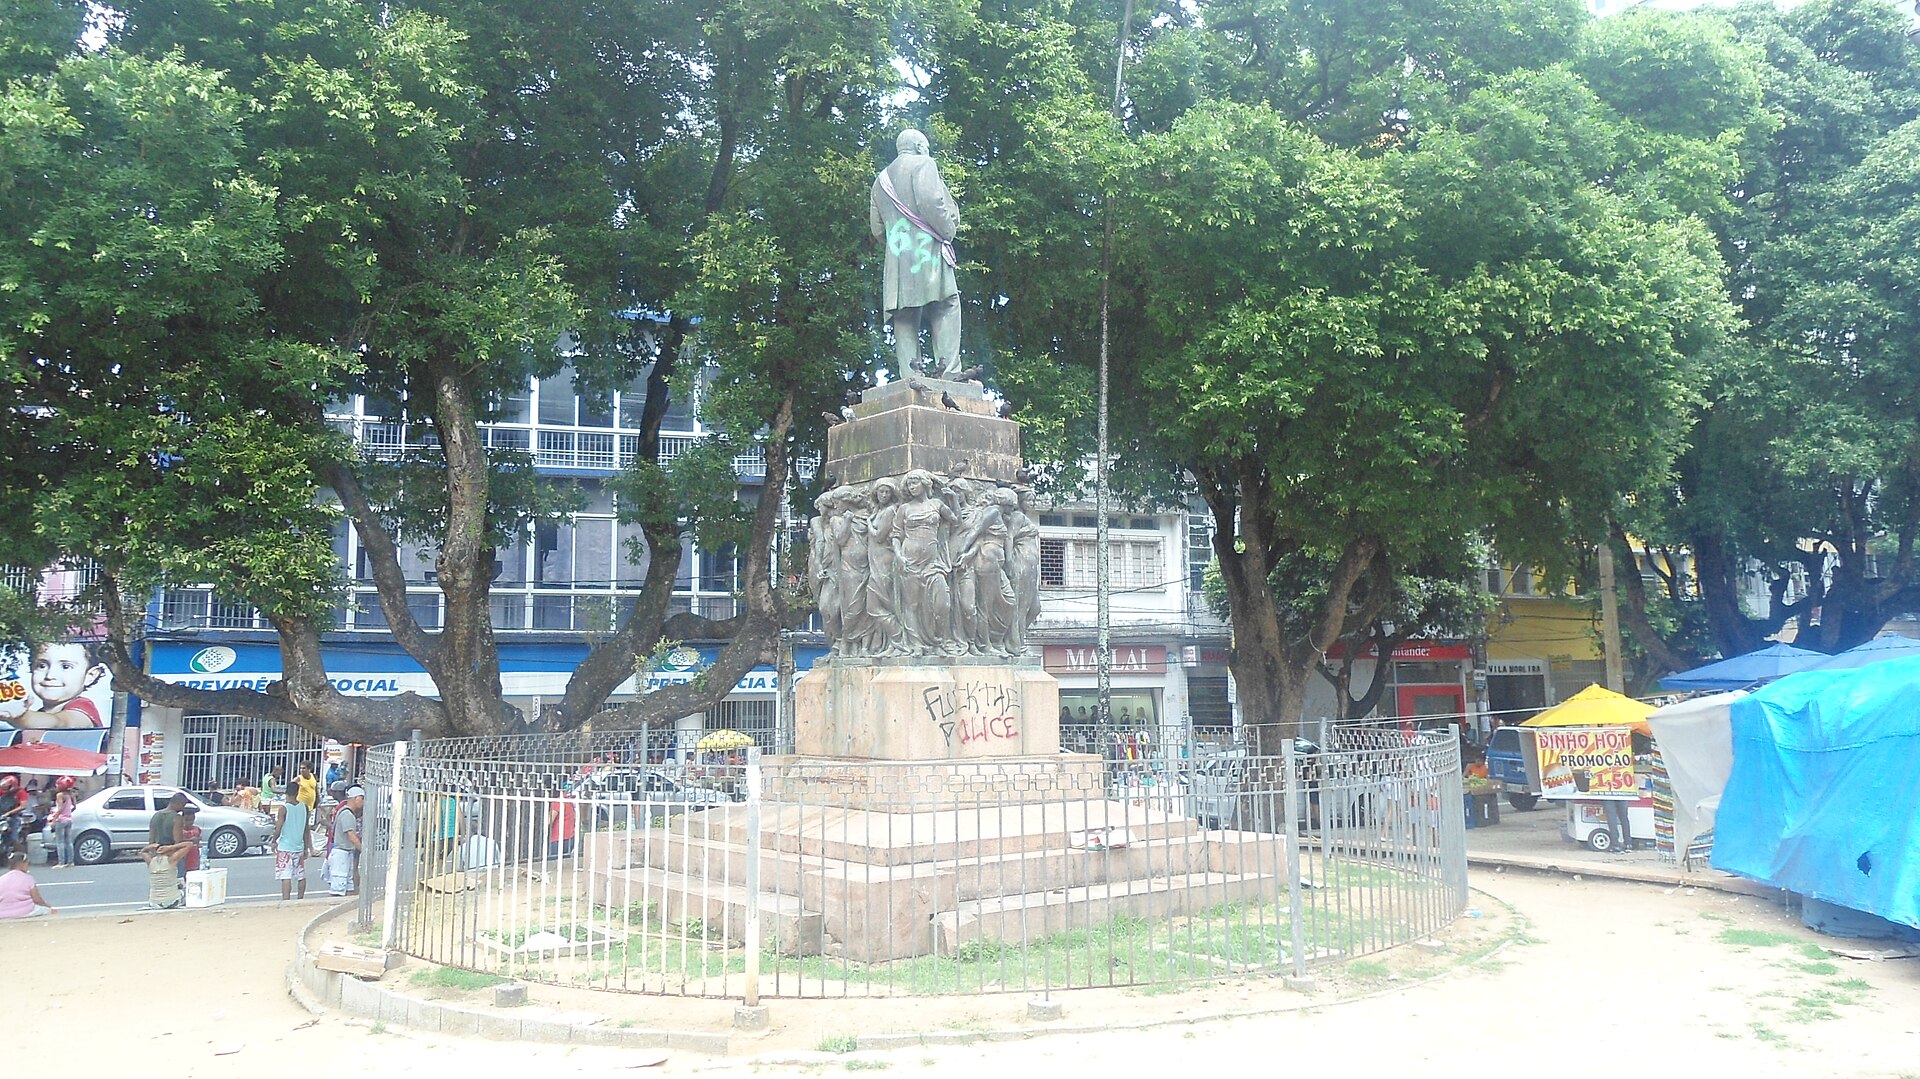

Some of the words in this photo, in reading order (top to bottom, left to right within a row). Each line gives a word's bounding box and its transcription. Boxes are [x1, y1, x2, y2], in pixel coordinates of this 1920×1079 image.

[1391, 644, 1430, 656] ntander
[328, 678, 399, 692] SOCIAL
[1540, 733, 1589, 749] DINHO
[1595, 732, 1627, 749] HOT
[1596, 772, 1635, 791] 1,50
